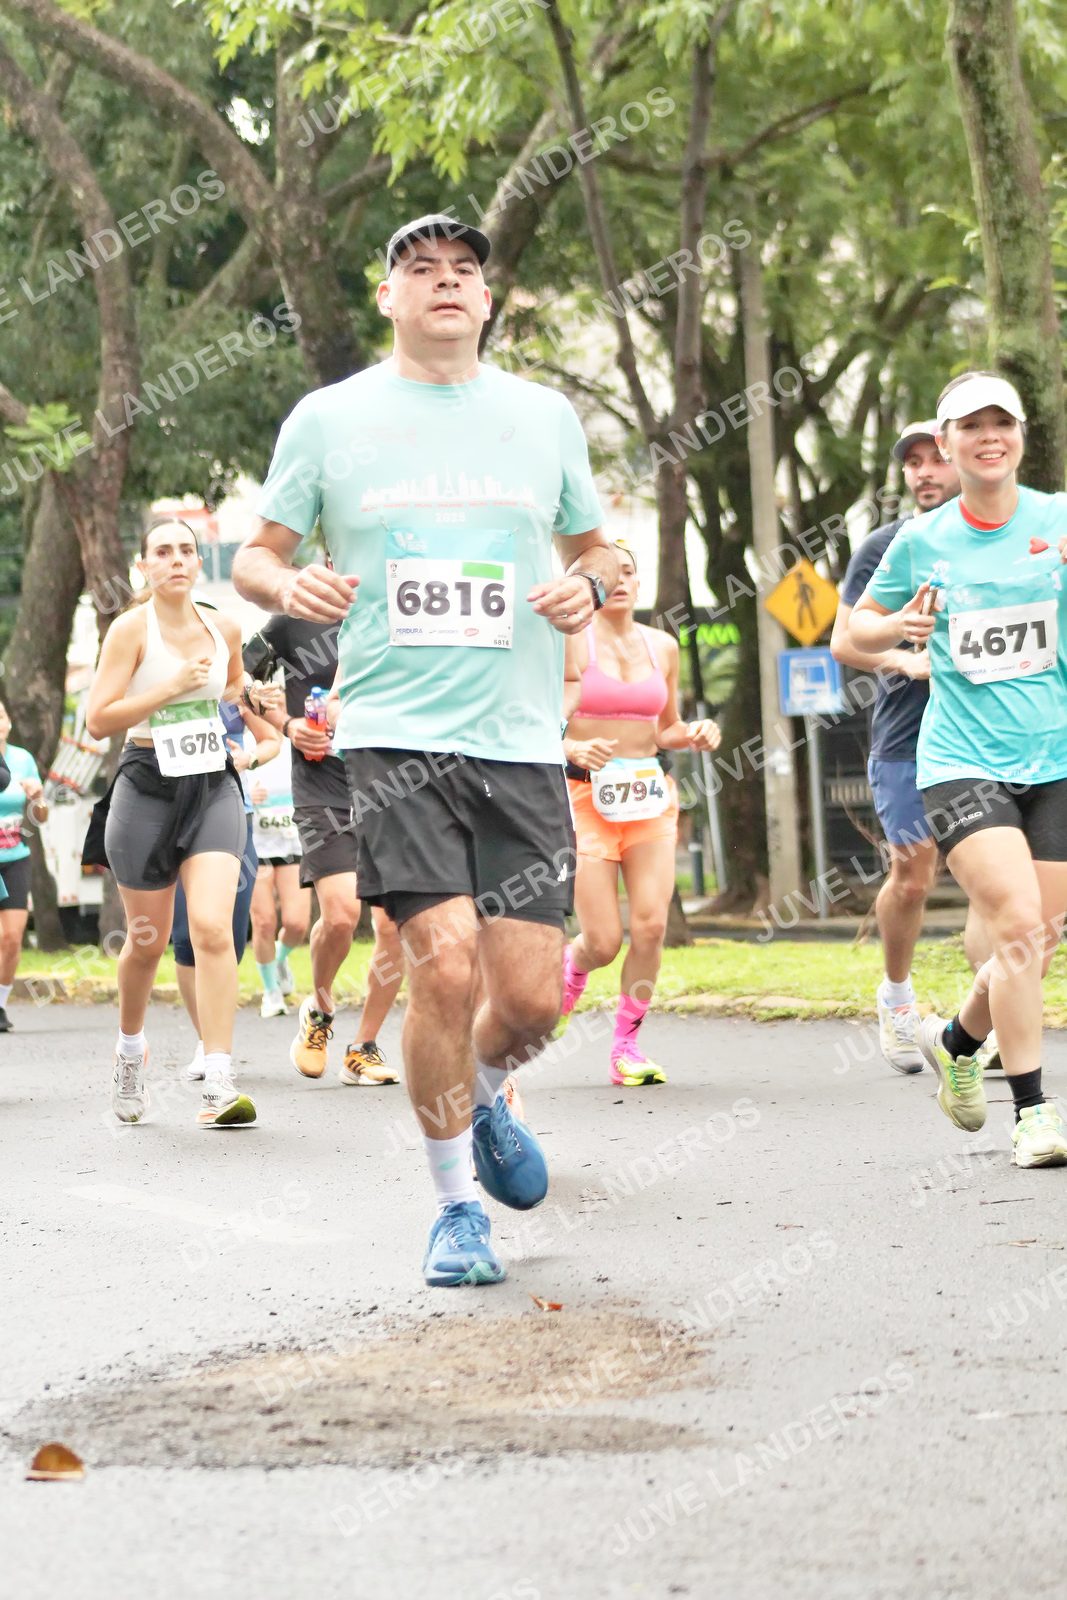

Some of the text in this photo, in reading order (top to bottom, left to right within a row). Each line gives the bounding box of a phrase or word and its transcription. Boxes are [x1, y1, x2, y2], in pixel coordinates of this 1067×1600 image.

[397, 581, 506, 618] 6816
[960, 620, 1047, 659] 4671
[162, 732, 219, 758] 1678
[599, 779, 664, 805] 6794
